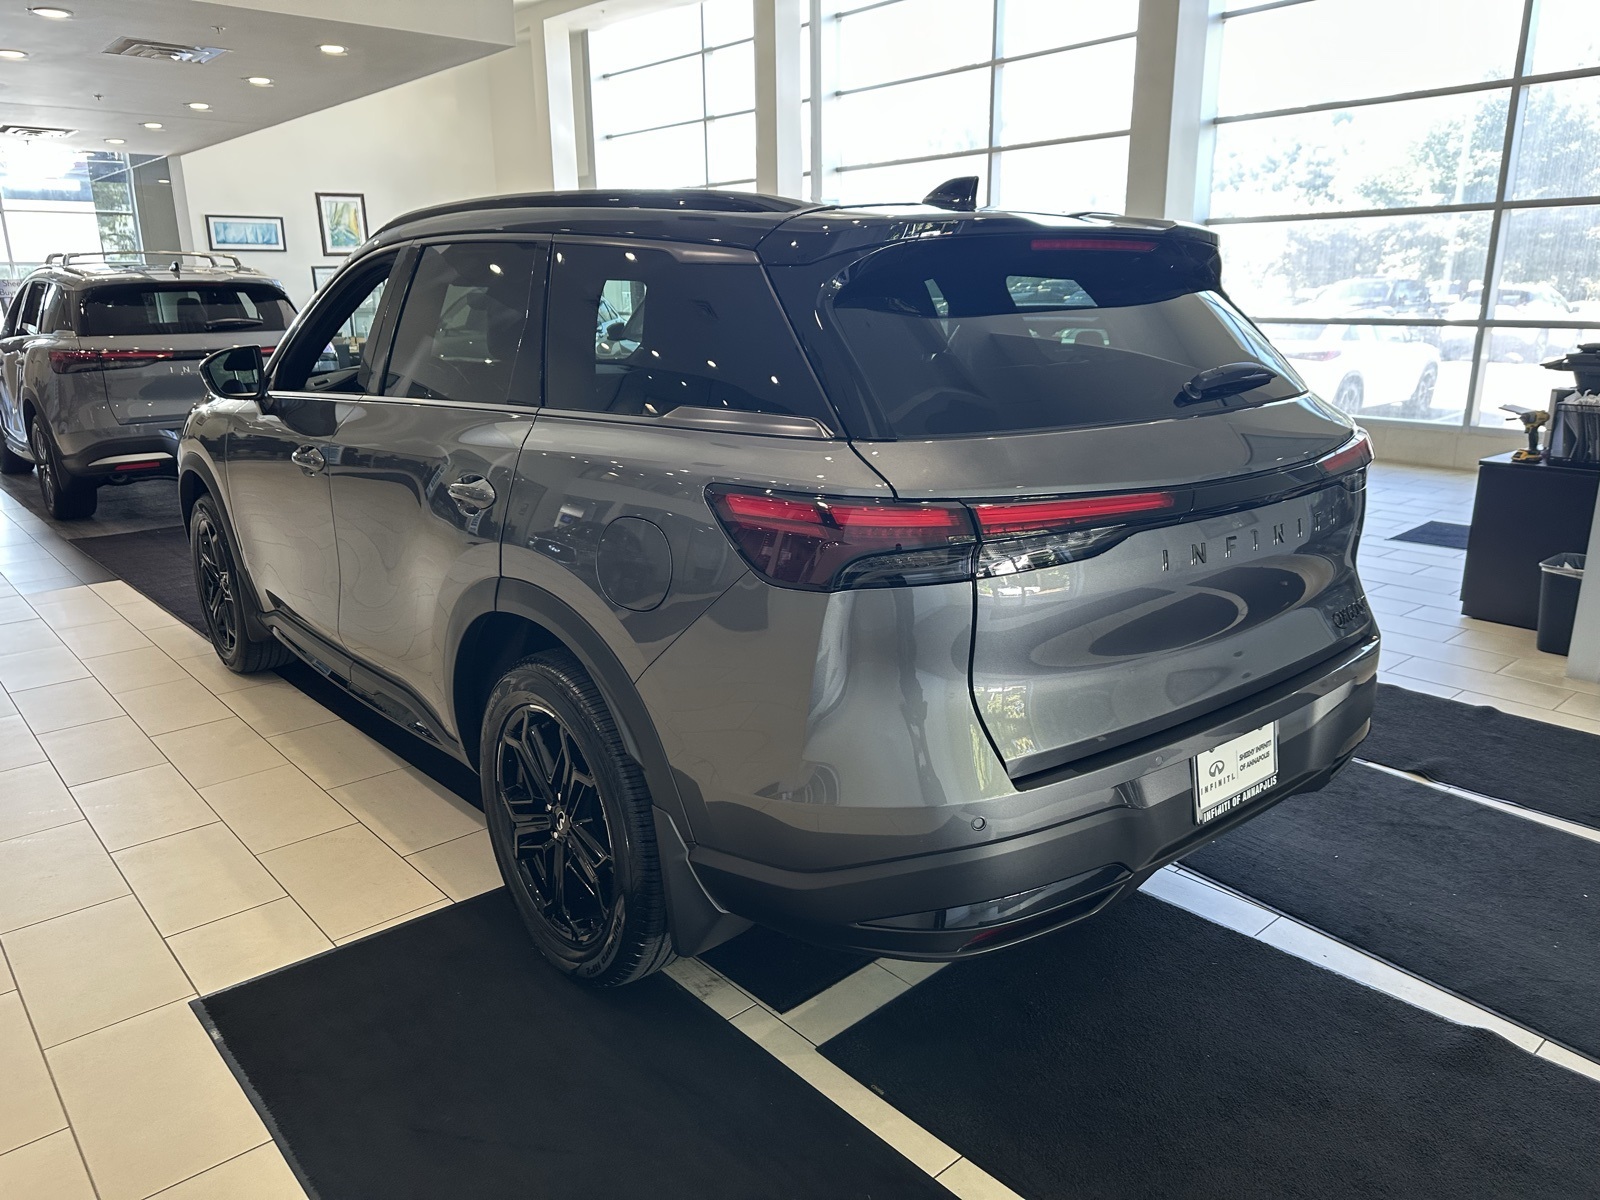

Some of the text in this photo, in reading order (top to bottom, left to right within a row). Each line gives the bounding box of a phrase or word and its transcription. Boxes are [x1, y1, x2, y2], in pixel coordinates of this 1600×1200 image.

[1162, 505, 1336, 572] INFINITI
[1239, 751, 1270, 772] OF ANNAPOLIS
[1203, 775, 1277, 823] INFINITI OF ANNAPOLIS
